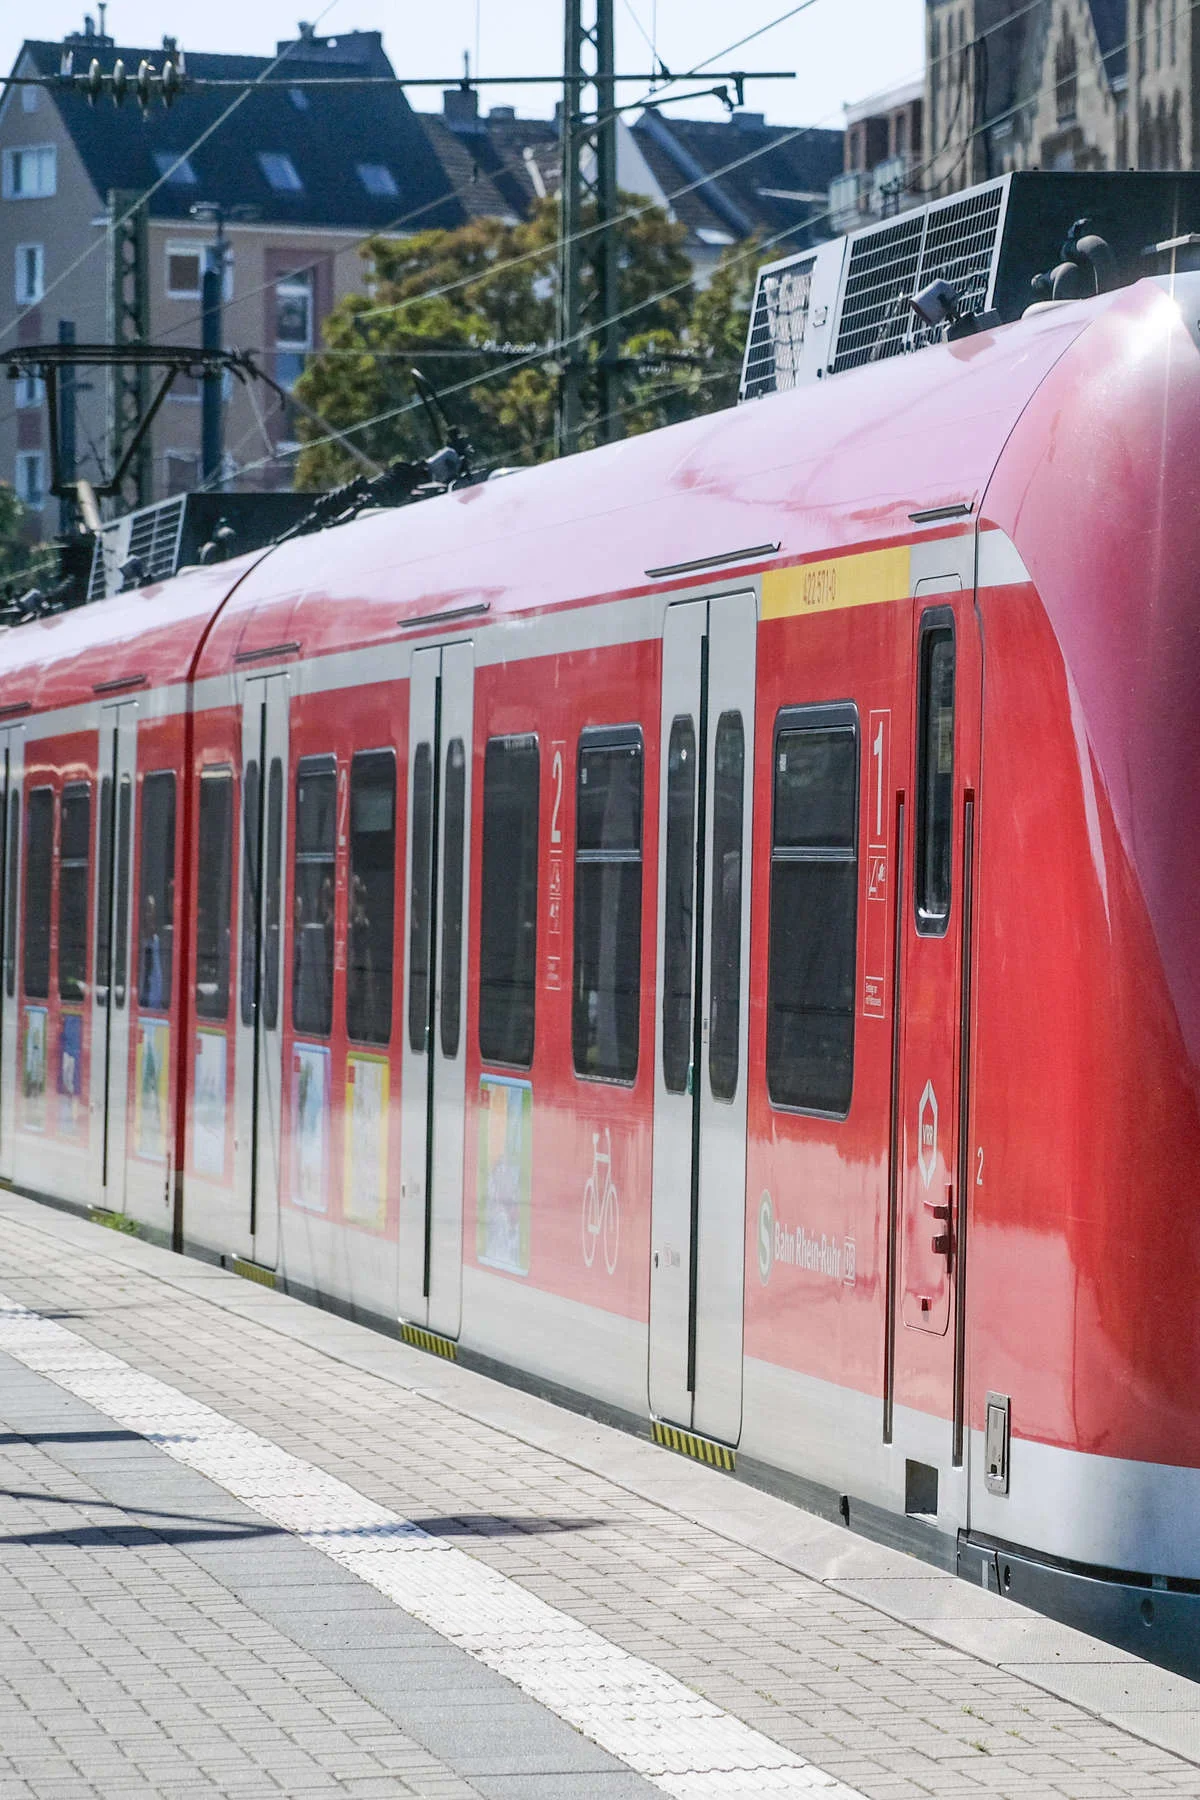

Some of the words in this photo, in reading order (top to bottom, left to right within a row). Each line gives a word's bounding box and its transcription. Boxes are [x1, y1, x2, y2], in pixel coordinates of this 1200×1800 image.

[551, 750, 562, 843] 2
[873, 720, 883, 836] 1
[976, 1147, 984, 1185] 2
[775, 1221, 795, 1265] Bahn
[796, 1227, 841, 1279] Rhein-Ruhr
